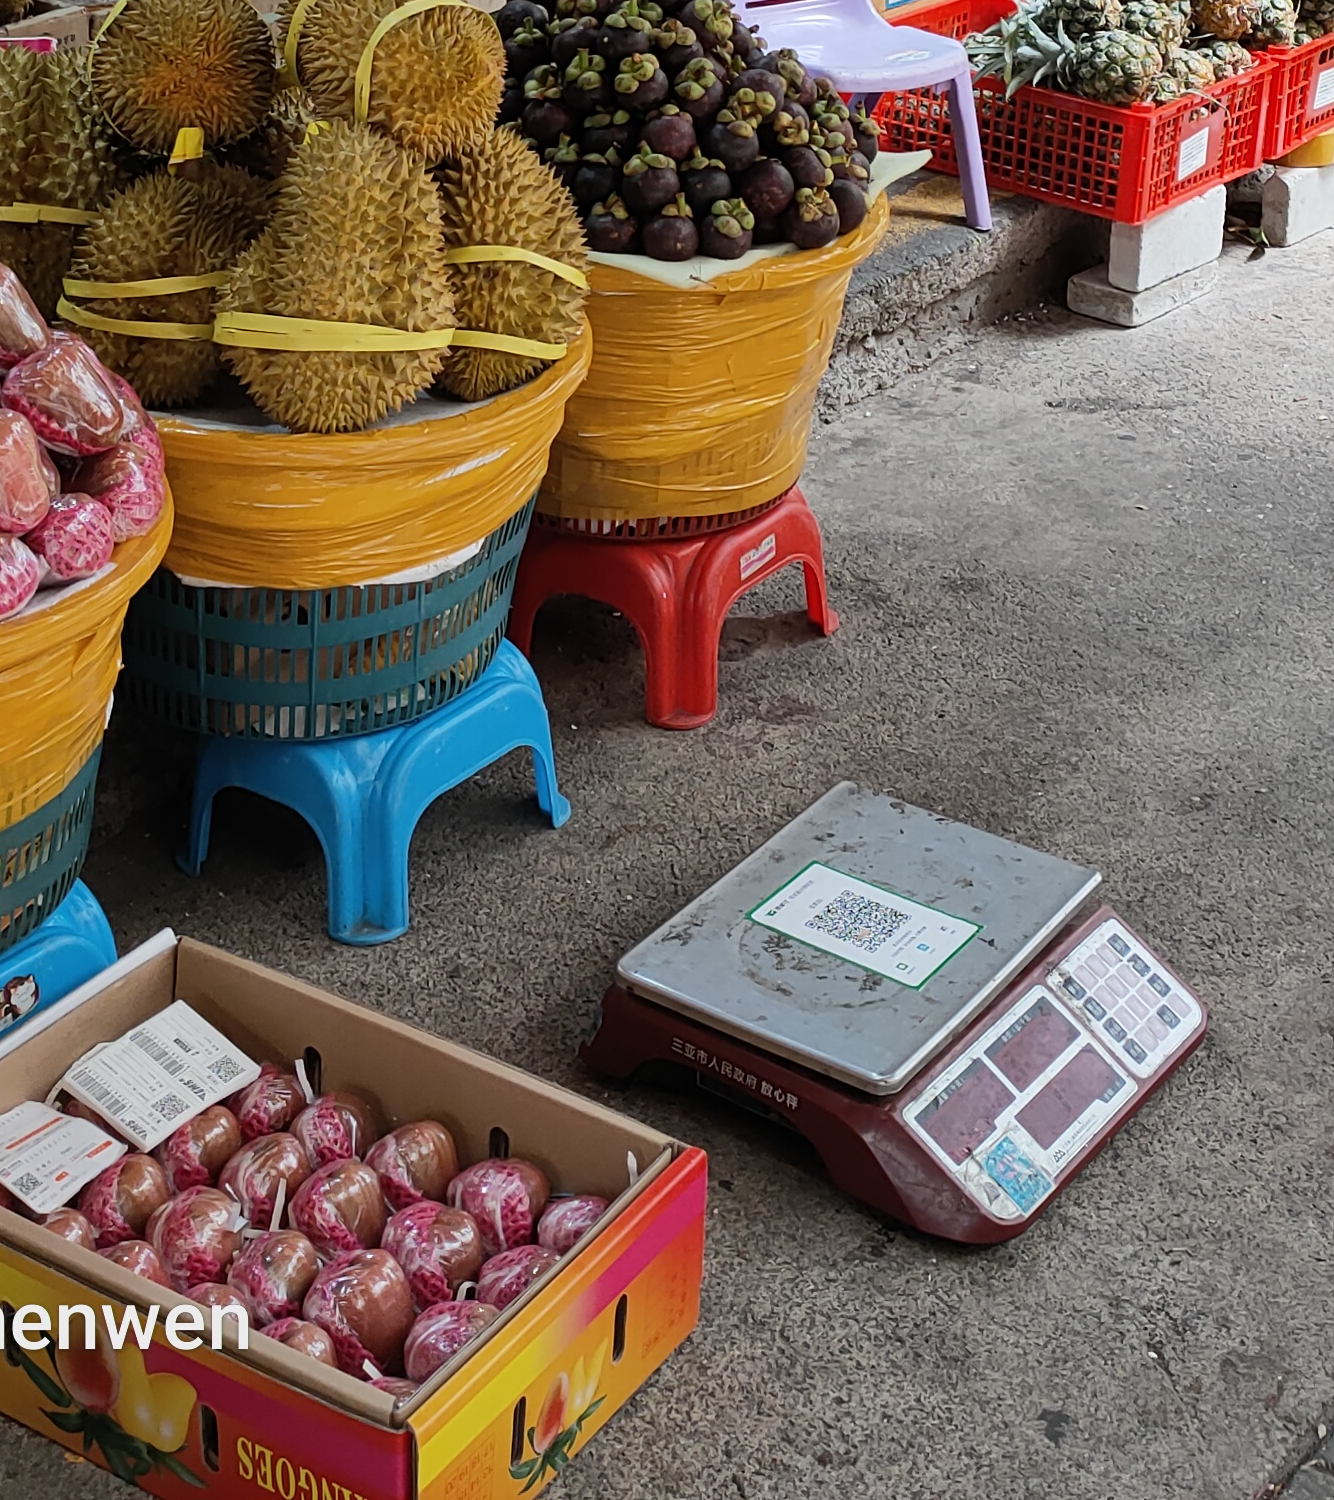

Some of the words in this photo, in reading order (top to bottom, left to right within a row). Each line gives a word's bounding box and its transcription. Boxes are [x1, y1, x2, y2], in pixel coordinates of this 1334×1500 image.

[671, 1037, 758, 1090] 三亚市人民政府
[760, 1080, 799, 1110] 放心秤
